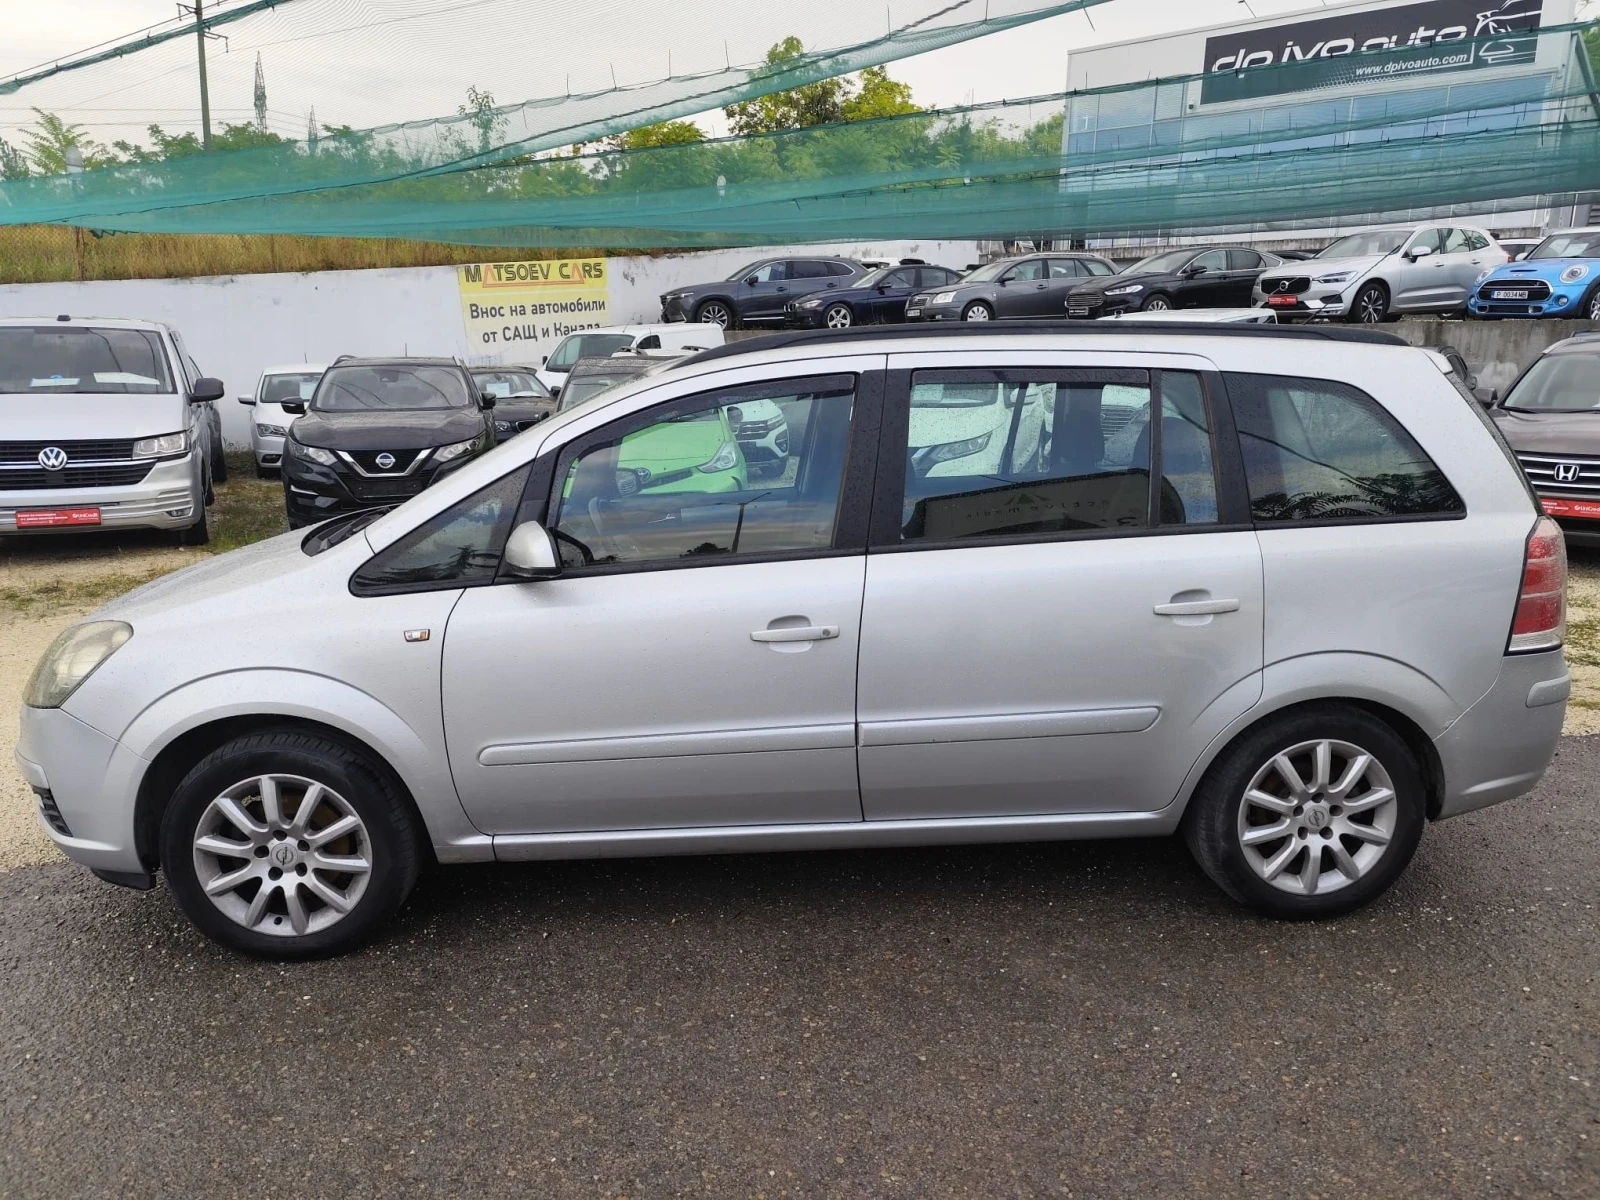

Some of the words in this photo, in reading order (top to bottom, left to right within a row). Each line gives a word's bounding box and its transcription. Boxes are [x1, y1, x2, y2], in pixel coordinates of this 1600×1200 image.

[1355, 54, 1467, 75] www.dpivoauto.com
[464, 263, 551, 283] MATSOEV
[559, 262, 603, 280] CARS
[469, 302, 505, 319] Внос
[510, 303, 526, 317] на
[531, 297, 606, 316] автомобили
[482, 331, 498, 344] от
[502, 323, 538, 342] САЩ
[541, 326, 550, 339] и
